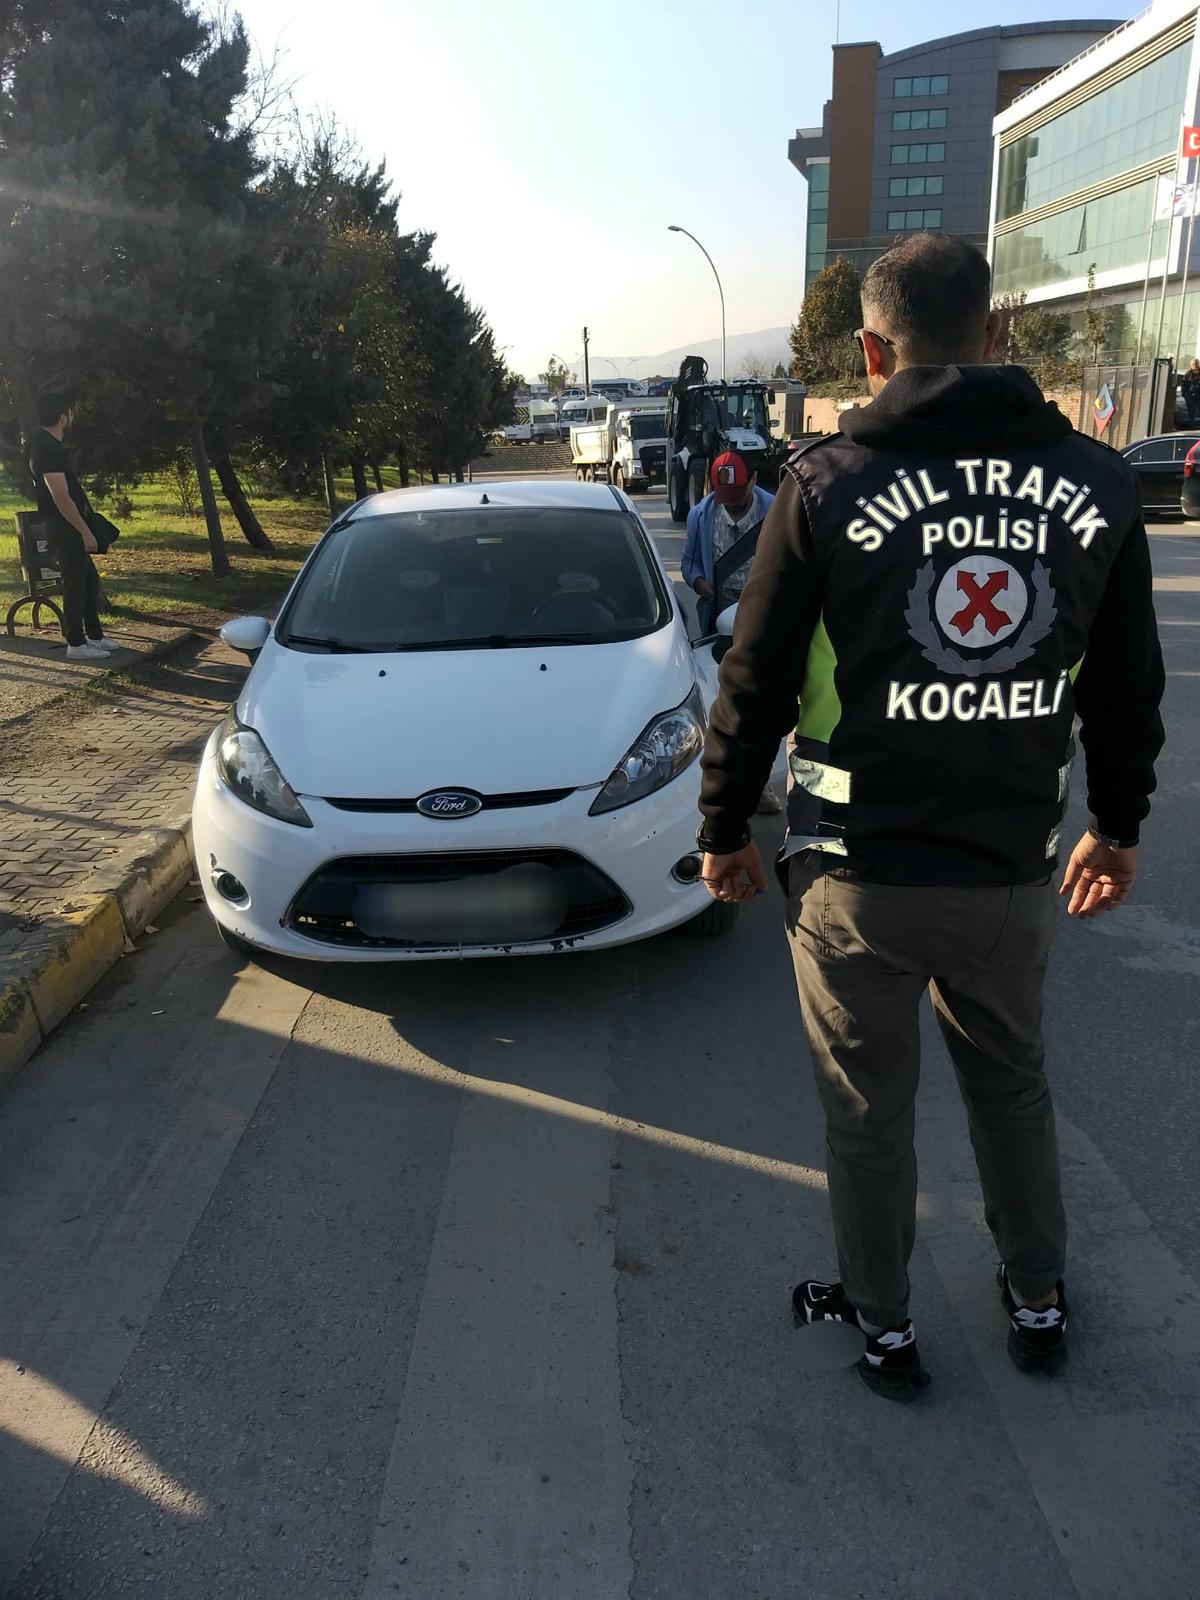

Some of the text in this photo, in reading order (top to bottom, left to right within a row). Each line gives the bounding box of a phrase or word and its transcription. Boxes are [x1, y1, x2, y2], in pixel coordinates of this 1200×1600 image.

[846, 458, 1109, 552] SİVİL TRAFİK
[921, 508, 1049, 555] POLİSİ
[885, 668, 1068, 722] KOCAELİ
[431, 795, 468, 812] Ford
